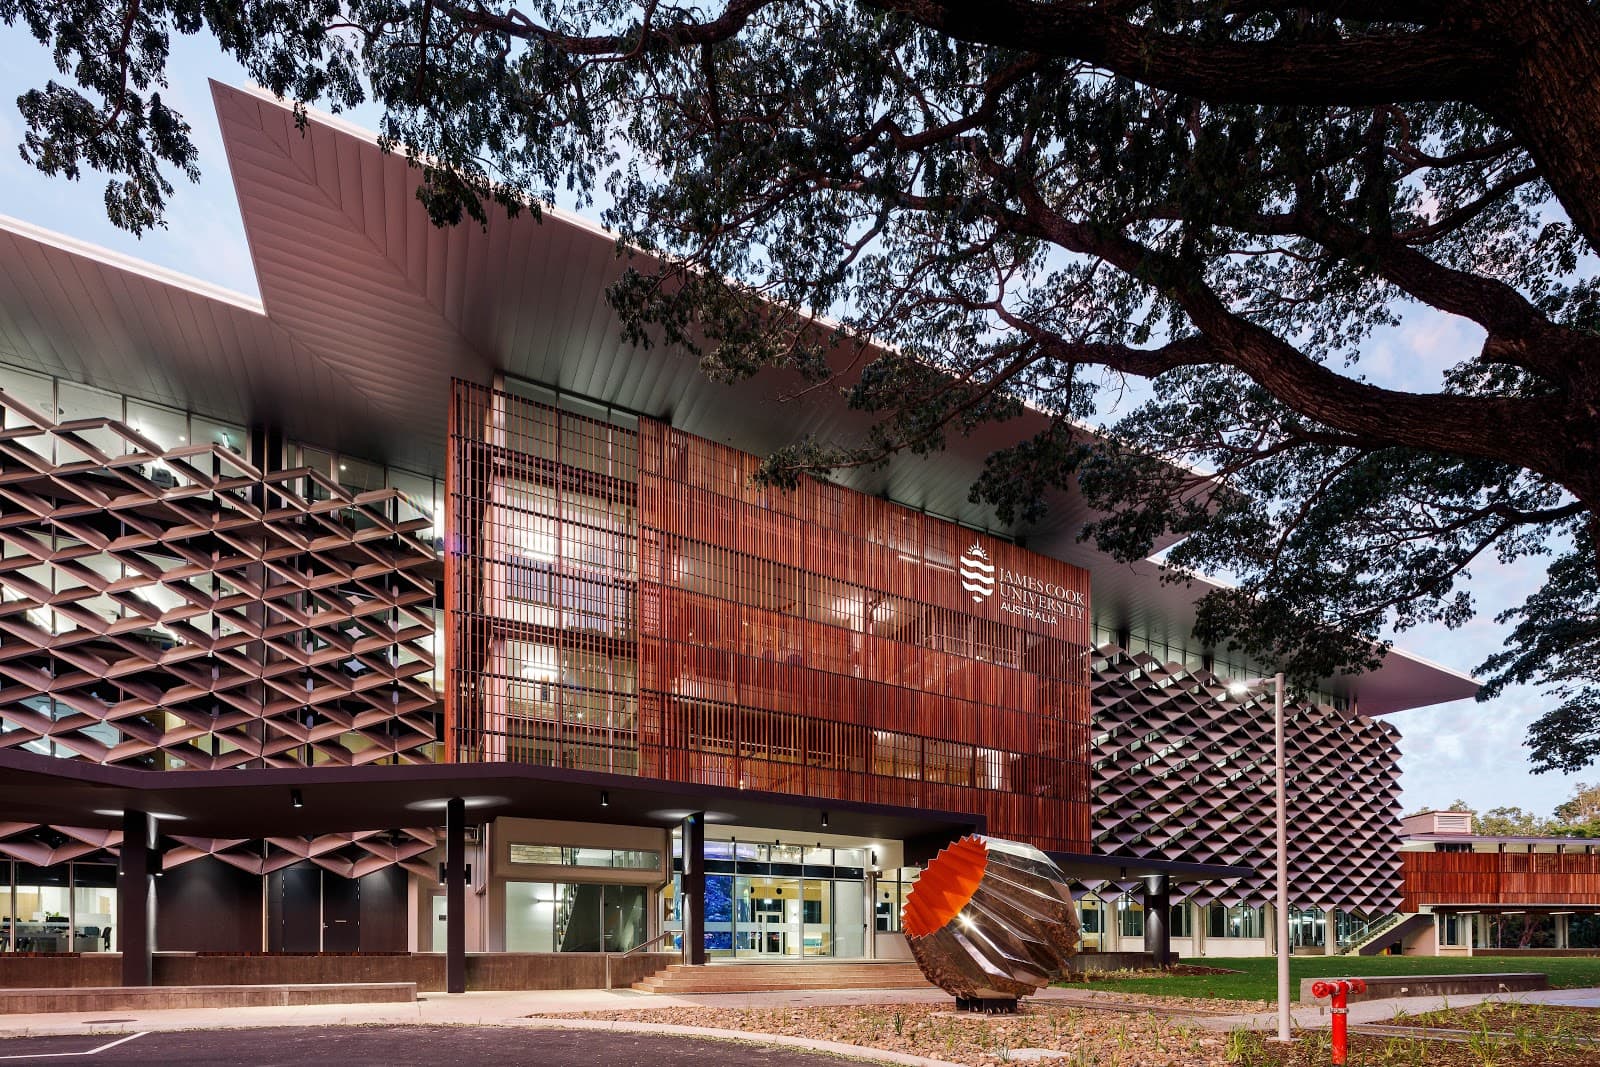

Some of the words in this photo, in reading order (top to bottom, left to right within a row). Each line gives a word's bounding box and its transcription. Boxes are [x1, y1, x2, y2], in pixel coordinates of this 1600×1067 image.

[1000, 567, 1044, 592] JAMES
[1045, 583, 1085, 606] COOK
[1000, 583, 1085, 619] UNIVERSITY
[1000, 602, 1057, 624] AUSTRALIA
